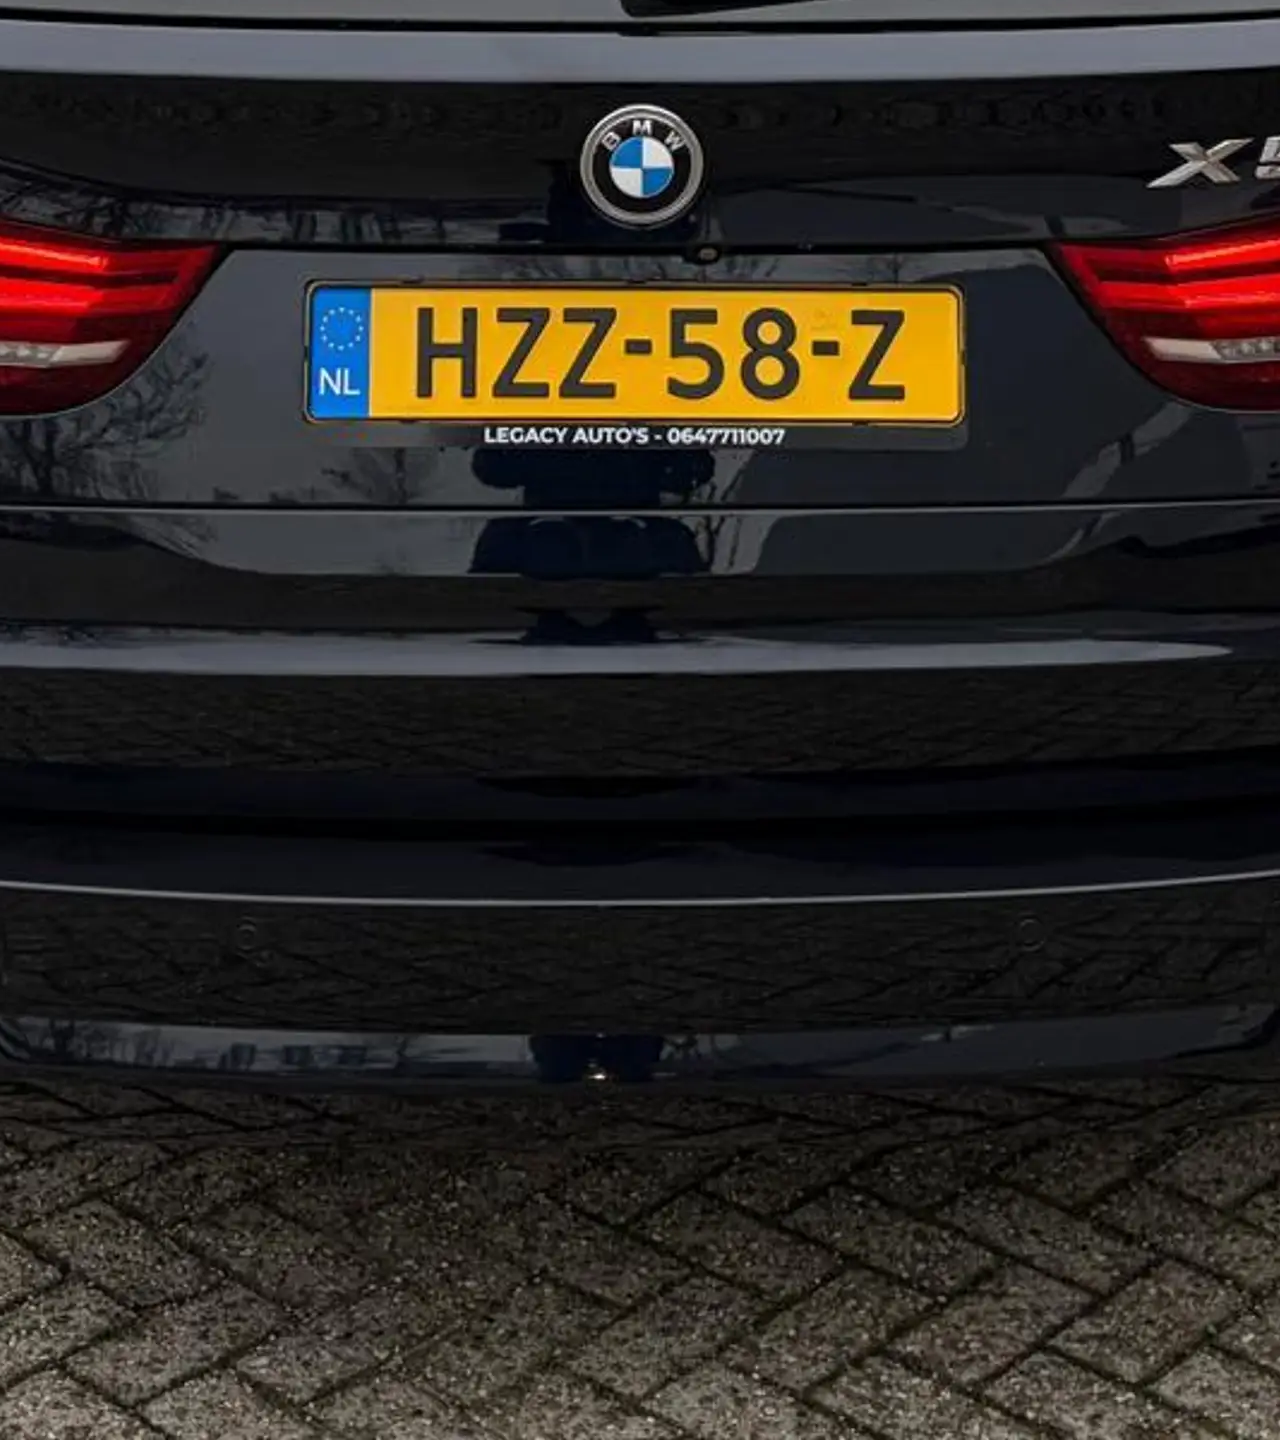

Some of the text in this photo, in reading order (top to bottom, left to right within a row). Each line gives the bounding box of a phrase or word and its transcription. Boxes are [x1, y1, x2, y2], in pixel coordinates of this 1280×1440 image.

[601, 118, 686, 152] BMW
[318, 306, 907, 401] NL HZZ-58-Z
[483, 426, 568, 444] LEGACY
[574, 426, 649, 445] AUTO'S
[665, 427, 786, 446] 0647711007
